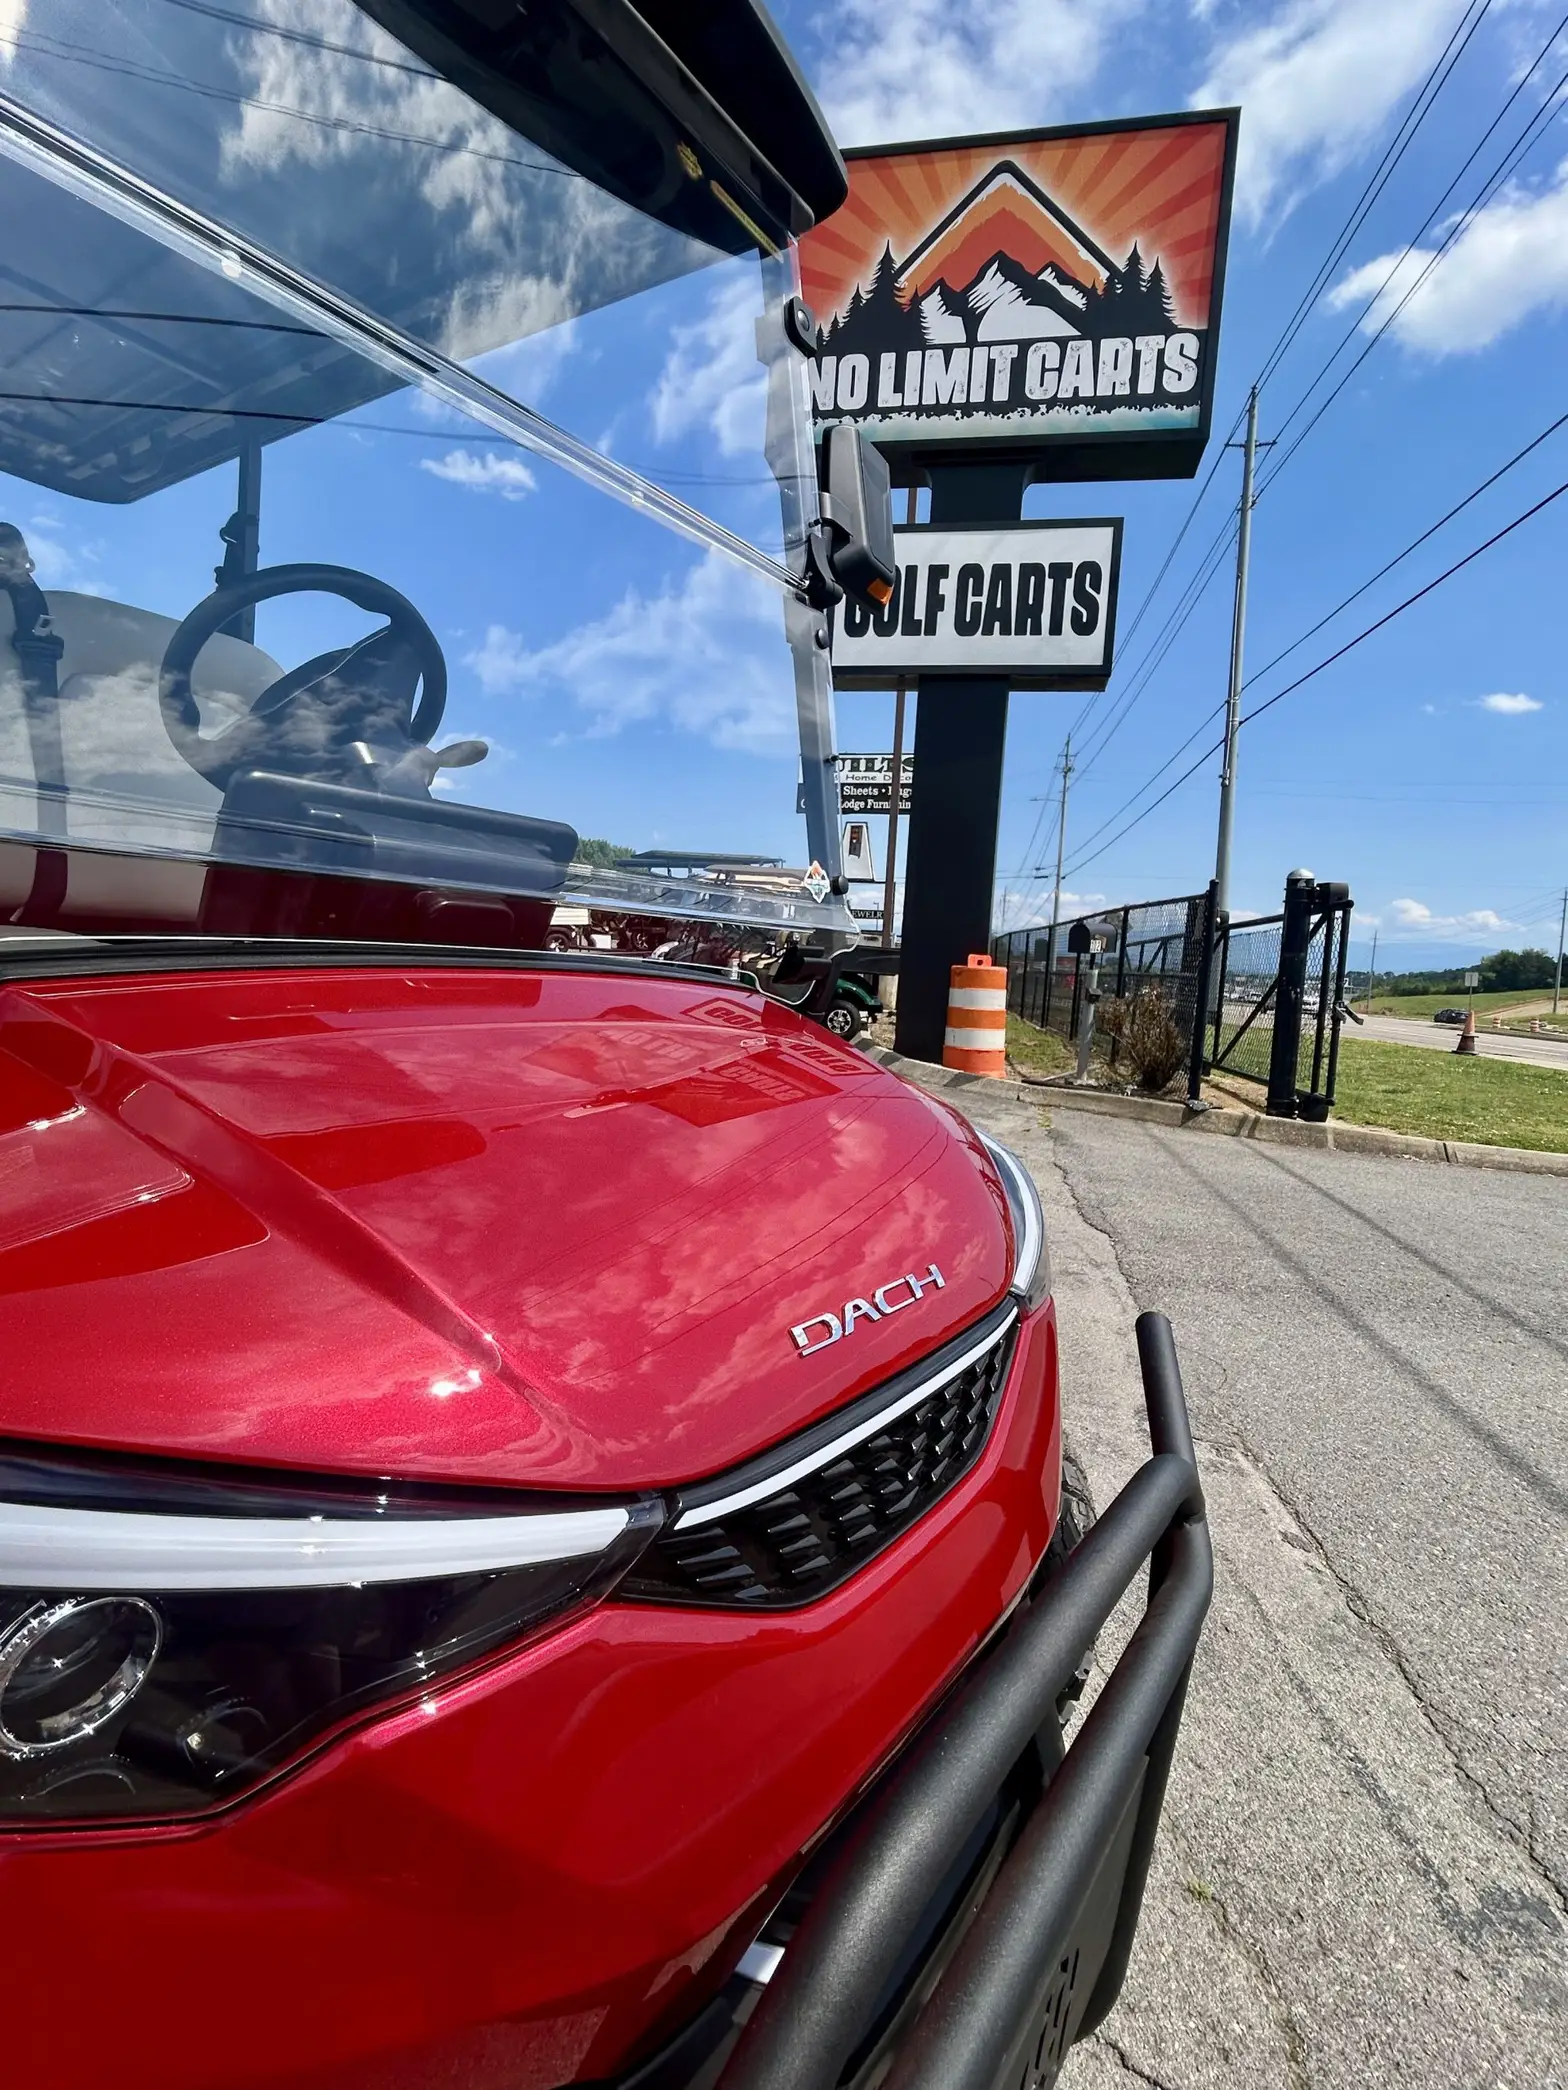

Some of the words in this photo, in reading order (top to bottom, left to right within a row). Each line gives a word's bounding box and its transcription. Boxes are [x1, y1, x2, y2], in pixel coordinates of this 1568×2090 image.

[808, 353, 870, 411] NO
[877, 344, 1019, 408] LIMIT
[1024, 332, 1199, 400] CARTS
[954, 560, 1103, 637] CARTS
[843, 785, 879, 796] Sheets
[846, 774, 878, 782] Home
[850, 910, 884, 919] EWELR
[789, 1263, 946, 1357] DACH
